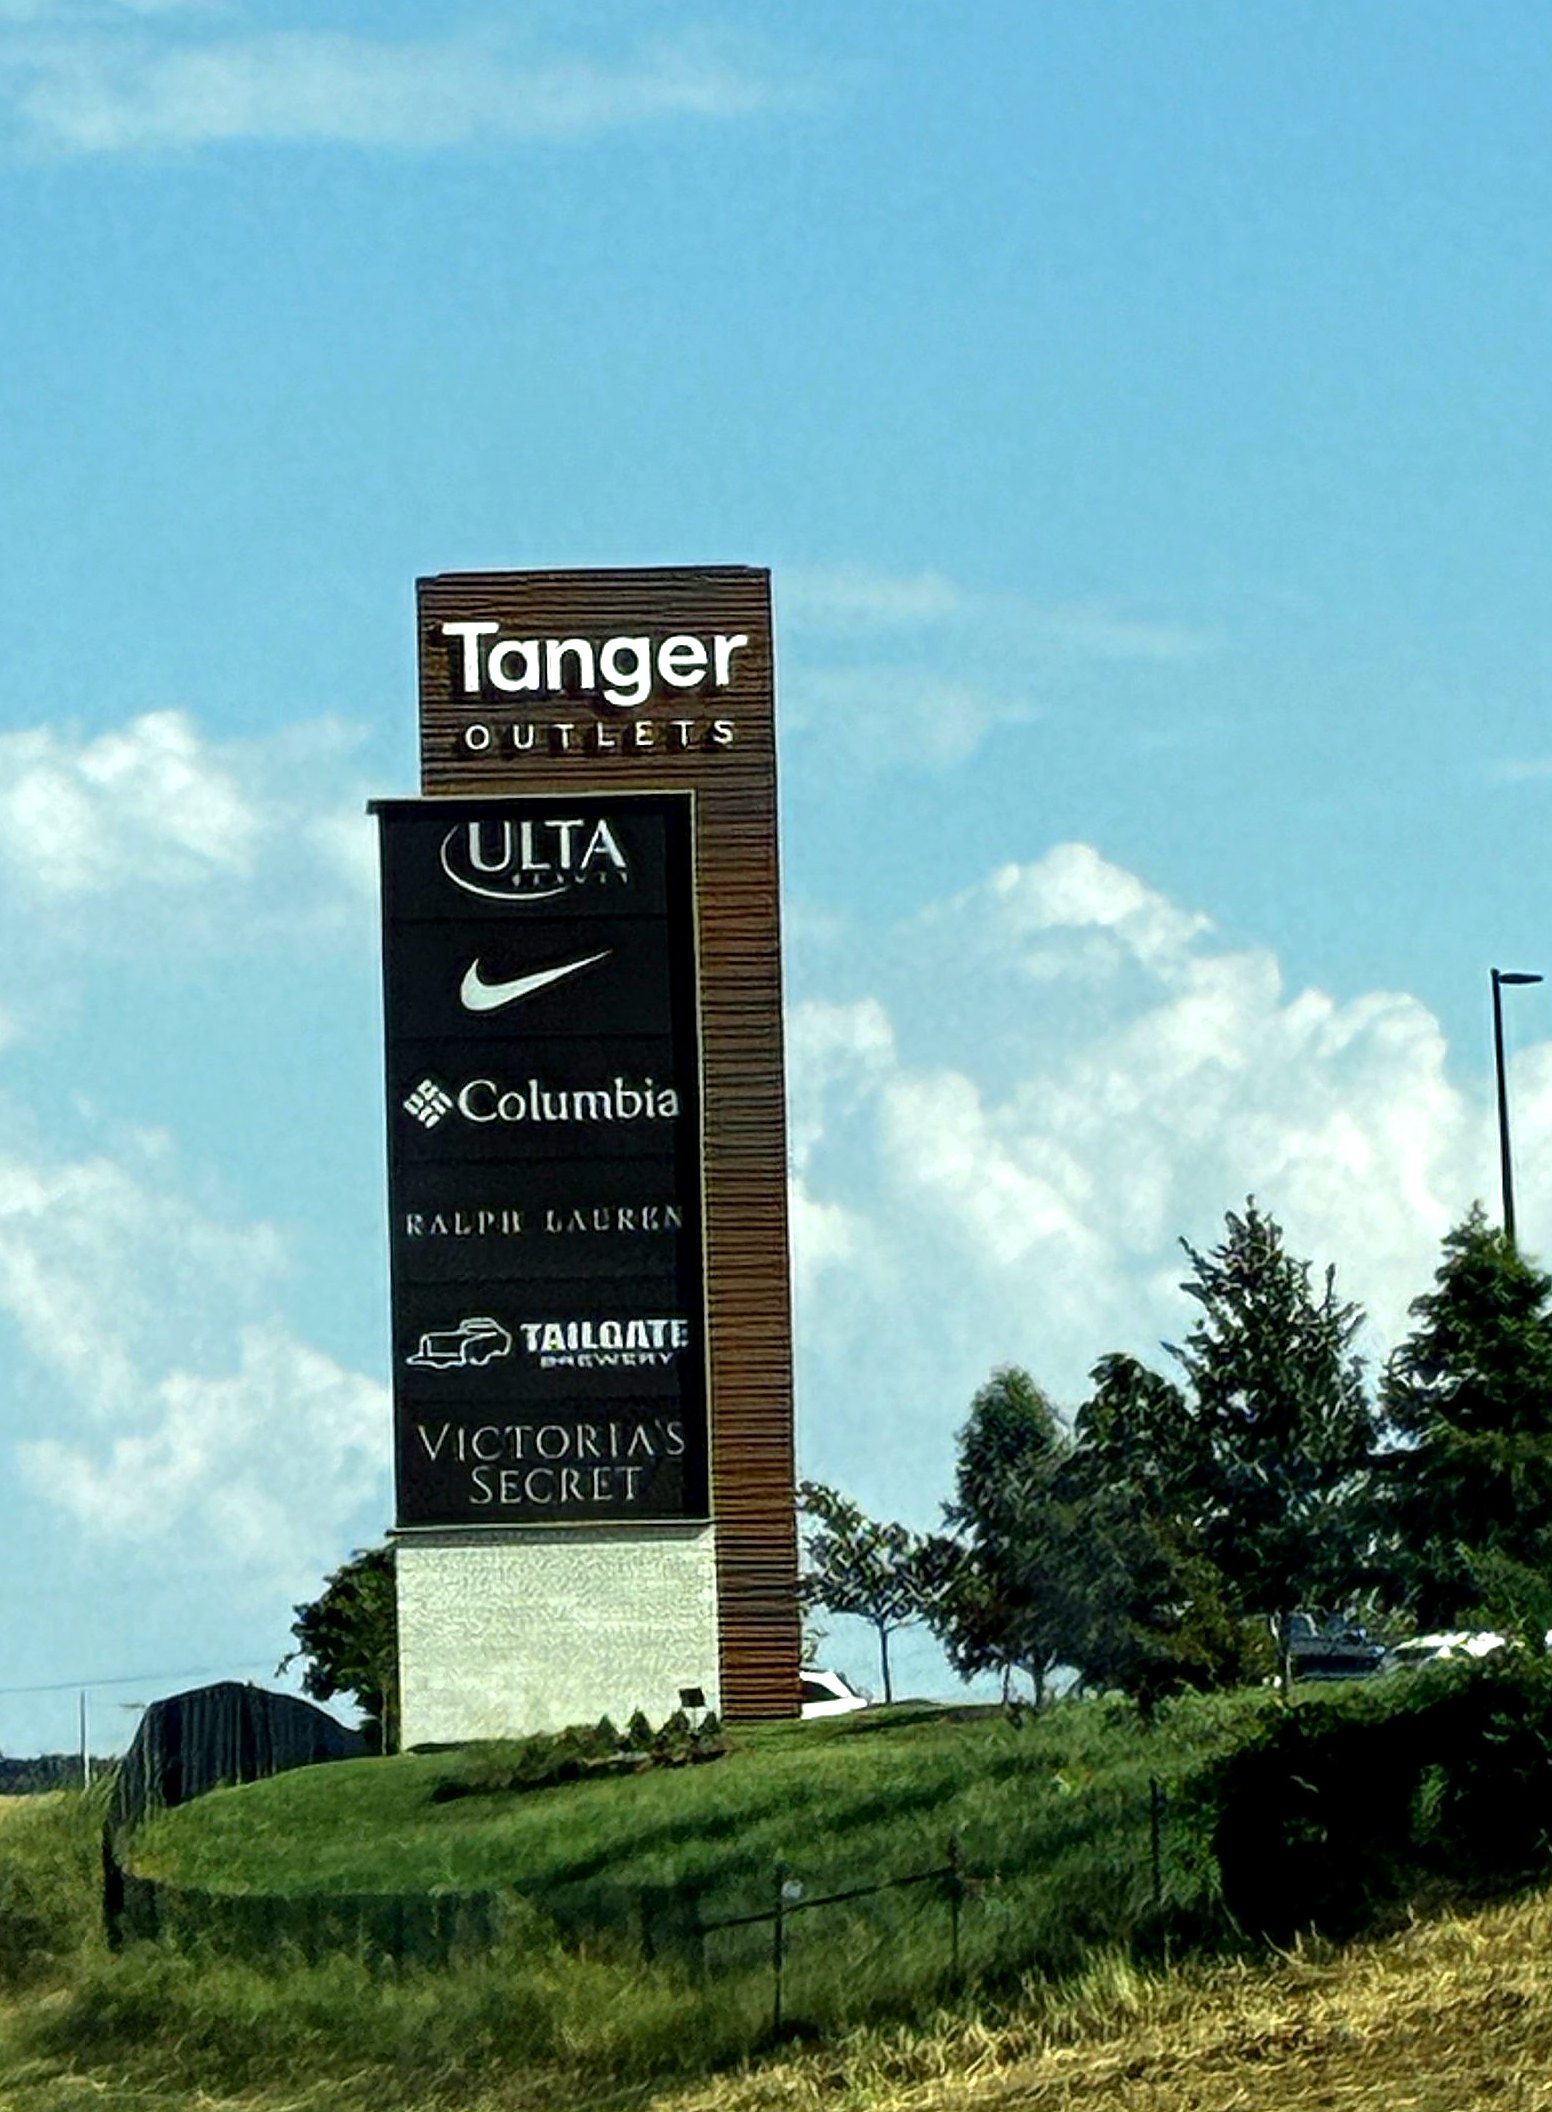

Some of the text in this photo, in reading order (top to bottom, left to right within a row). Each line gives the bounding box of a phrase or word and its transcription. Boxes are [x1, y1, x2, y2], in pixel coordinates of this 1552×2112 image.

[442, 621, 748, 707] Tanger
[465, 719, 736, 751] OUTLETS
[467, 819, 628, 873] ULTA
[457, 1077, 682, 1123] Columbia
[406, 1205, 684, 1236] RALPH LAUREN
[520, 1319, 690, 1352] TAILGATE
[417, 1419, 686, 1462] VICTORIA'S
[469, 1465, 644, 1505] SECRET
